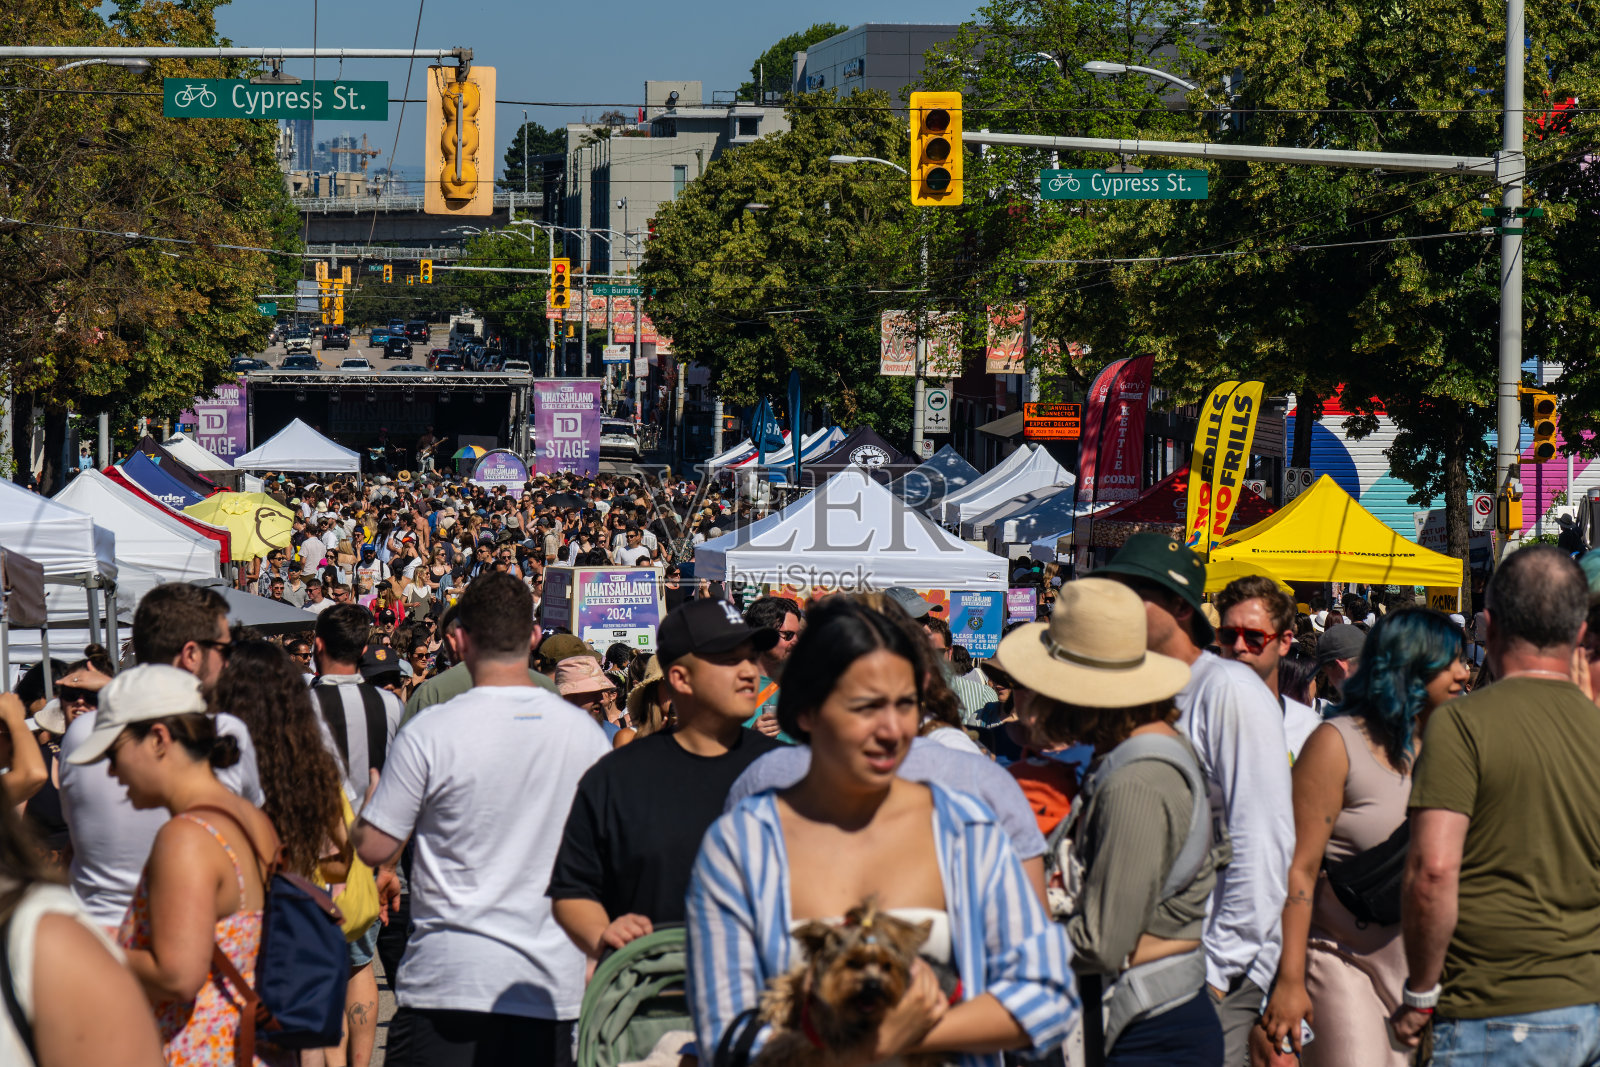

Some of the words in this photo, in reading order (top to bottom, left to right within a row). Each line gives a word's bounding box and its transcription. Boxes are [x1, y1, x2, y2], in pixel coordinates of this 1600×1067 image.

[232, 84, 322, 114] Cypress
[333, 86, 366, 110] St.
[1092, 173, 1159, 196] Cypress
[1166, 173, 1192, 192] St.
[202, 414, 224, 430] TD
[556, 418, 578, 432] TD
[196, 436, 236, 455] TAGE
[1114, 406, 1130, 470] KETTLE
[545, 440, 590, 458] STAGE
[1104, 475, 1135, 484] CORN
[584, 582, 652, 596] KHATSAHLANO
[607, 608, 632, 620] 2024
